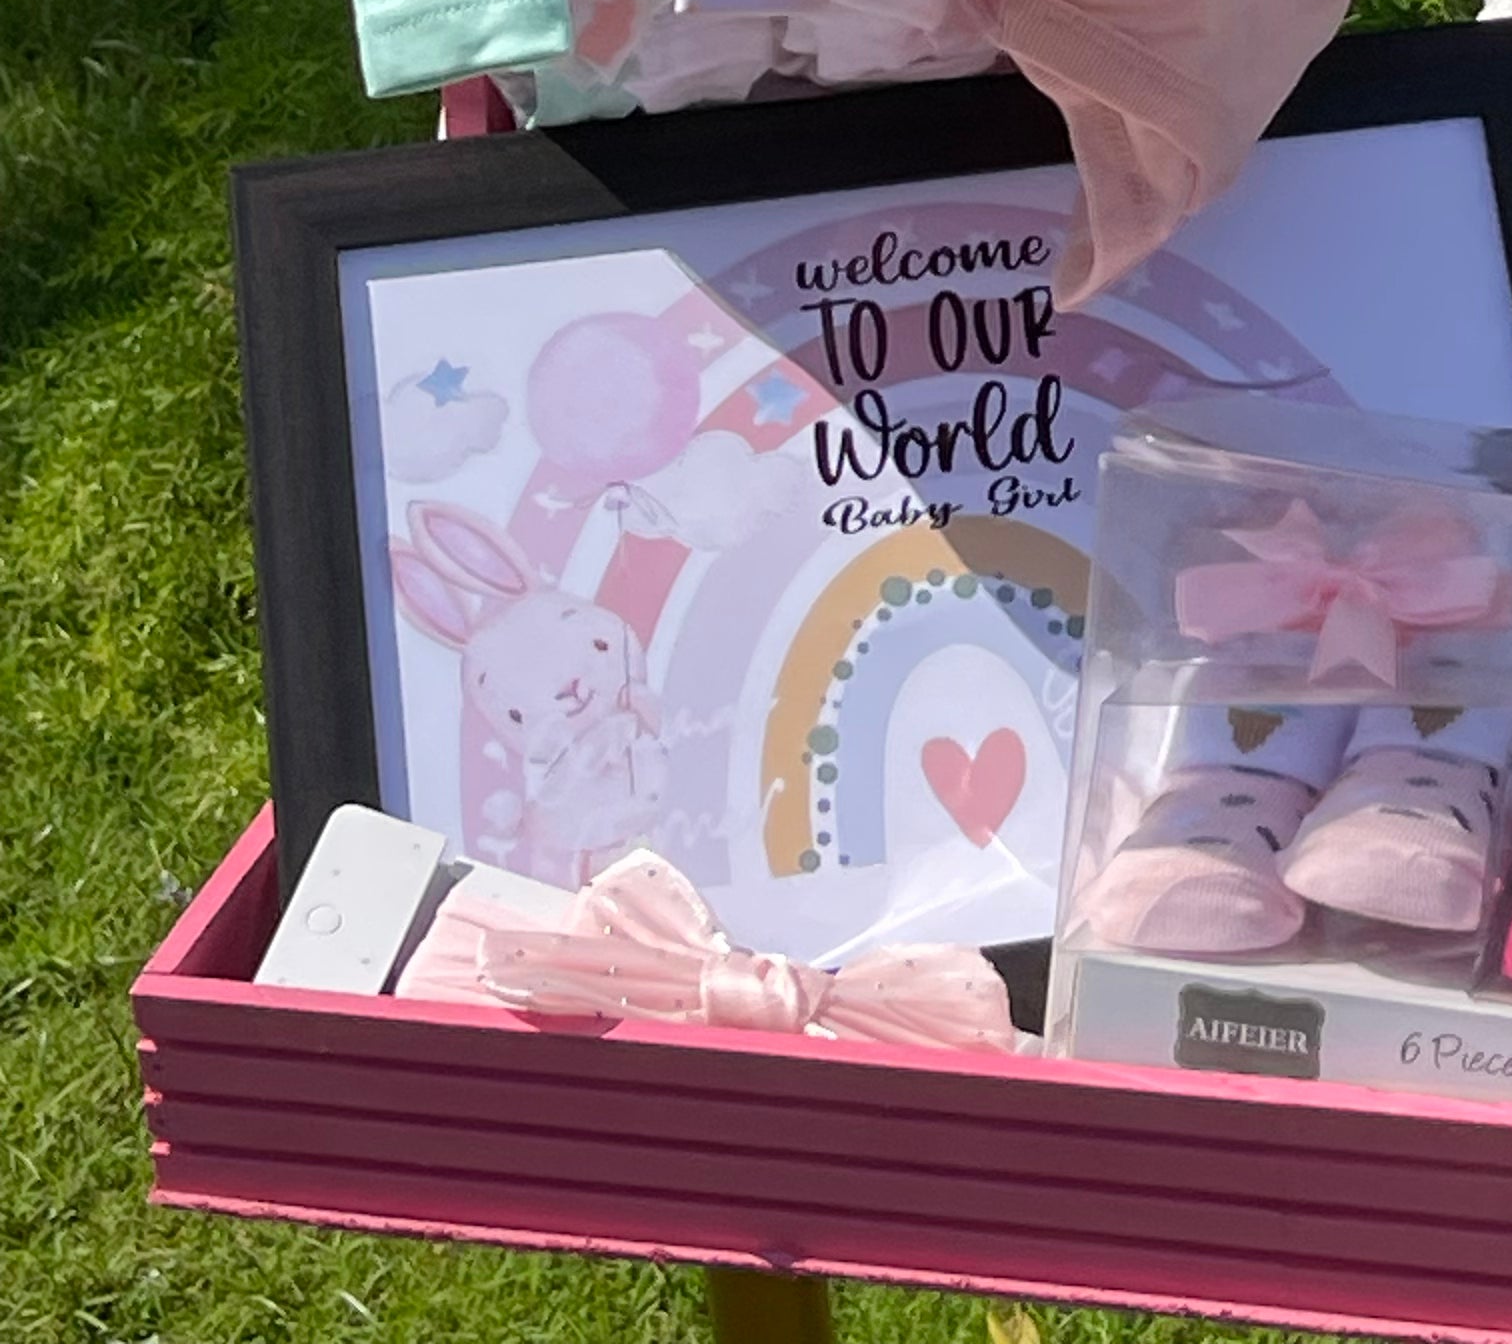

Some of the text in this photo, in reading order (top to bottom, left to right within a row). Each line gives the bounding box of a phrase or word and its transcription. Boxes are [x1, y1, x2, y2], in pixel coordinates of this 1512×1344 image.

[796, 231, 1051, 291] welcome
[800, 285, 1056, 385] TO OUR
[814, 374, 1075, 486] World
[822, 475, 1082, 535] Baby Girl
[1186, 1016, 1309, 1054] AIFEIER
[1400, 1031, 1423, 1064] 6
